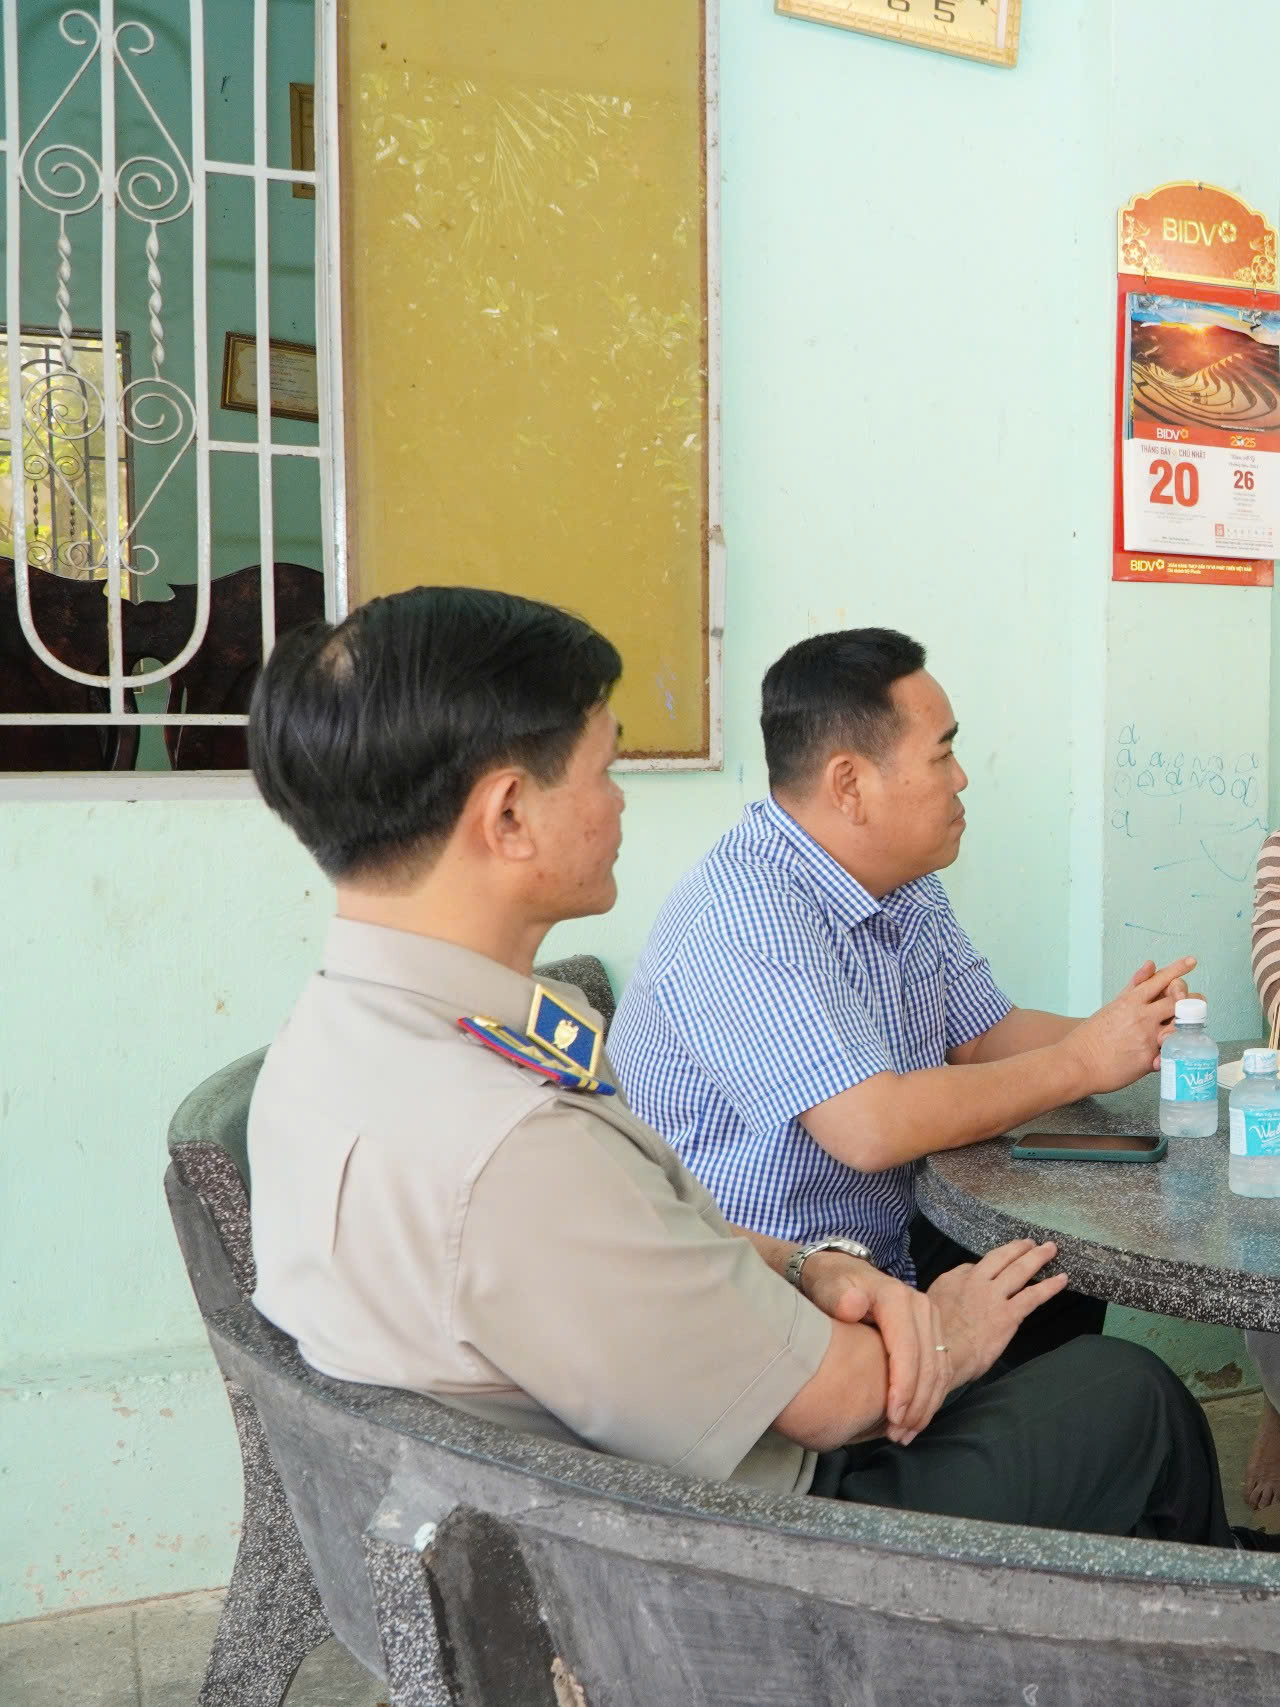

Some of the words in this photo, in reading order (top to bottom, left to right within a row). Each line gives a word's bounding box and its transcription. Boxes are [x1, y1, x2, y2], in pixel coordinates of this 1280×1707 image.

[1162, 217, 1218, 246] BIDV
[1156, 427, 1181, 440] BIDV
[1149, 459, 1199, 507] 20
[1233, 469, 1255, 491] 26
[1130, 559, 1156, 572] BIDV
